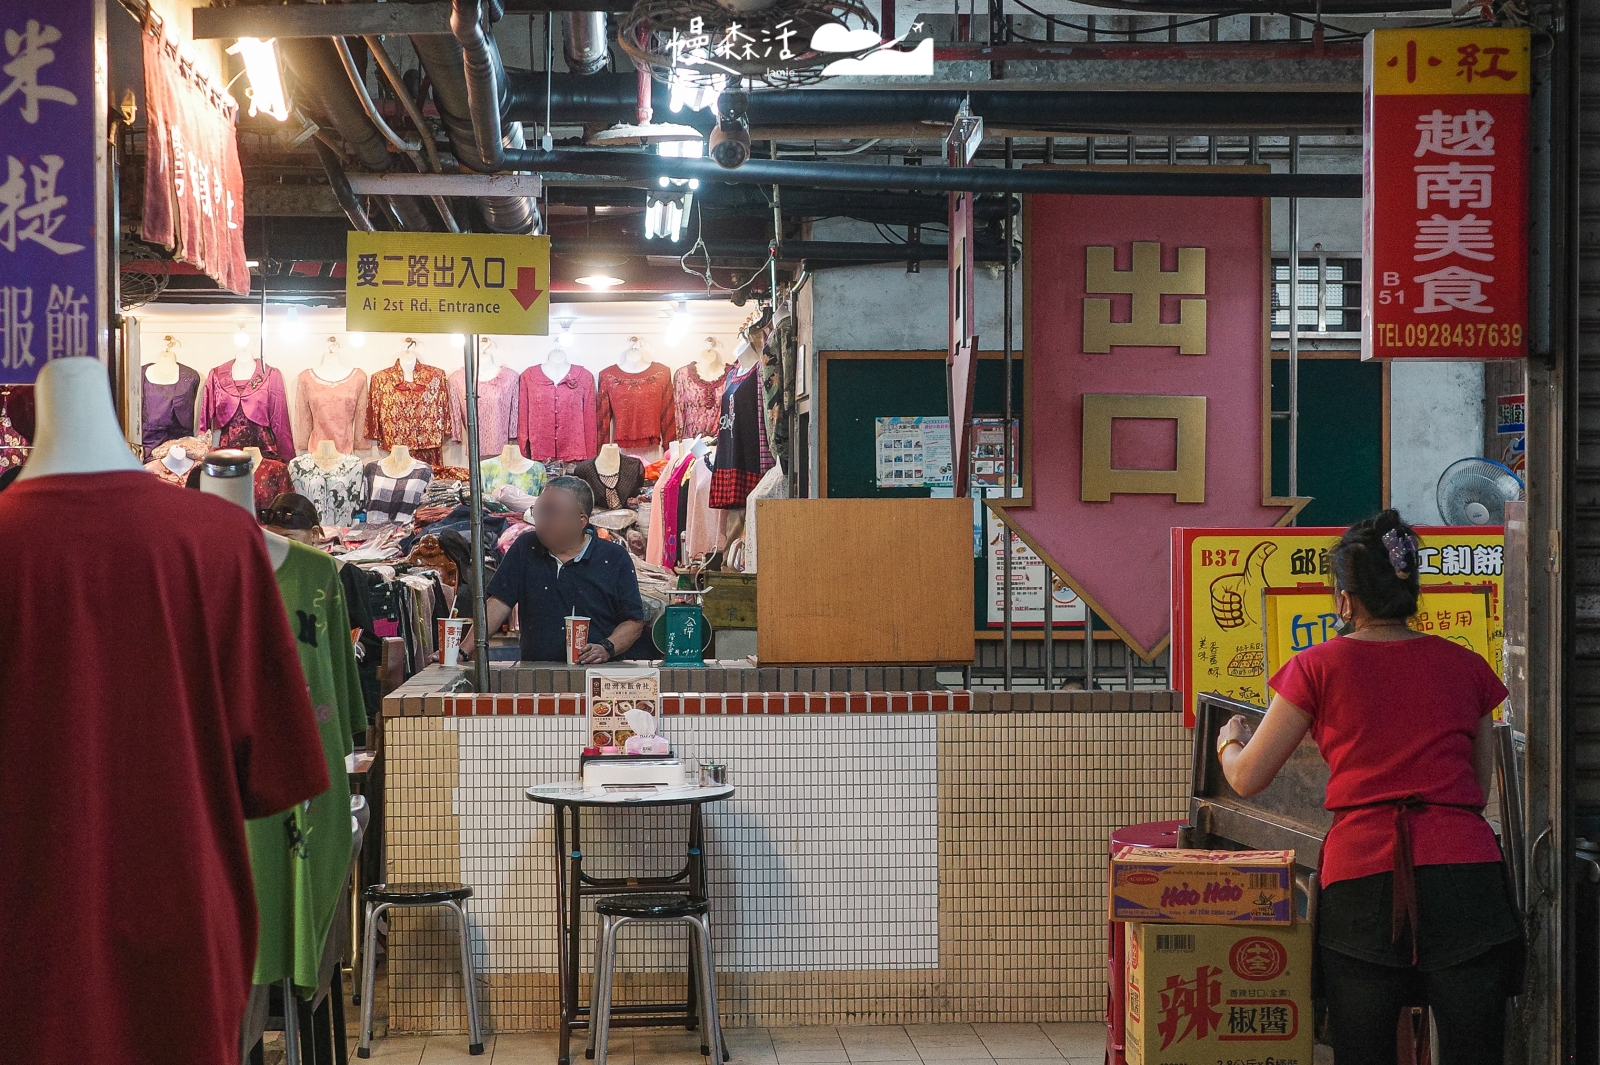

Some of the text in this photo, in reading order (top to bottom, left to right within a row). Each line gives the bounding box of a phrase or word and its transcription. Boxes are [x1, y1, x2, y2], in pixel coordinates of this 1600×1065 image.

[1386, 39, 1518, 84] 小紅
[0, 19, 86, 255] 米提
[1413, 108, 1496, 314] 越南美食
[356, 252, 506, 290] 愛二路出入口
[1383, 271, 1400, 286] B
[363, 297, 500, 314] Ai 2st Rd. Entrance
[1081, 241, 1208, 503] 出口
[1201, 549, 1240, 567] B37
[1417, 545, 1504, 575] 工制餅
[1160, 878, 1243, 908] Hảo Hảo
[1157, 964, 1223, 1052] 辣
[1227, 1006, 1289, 1034] 椒醬
